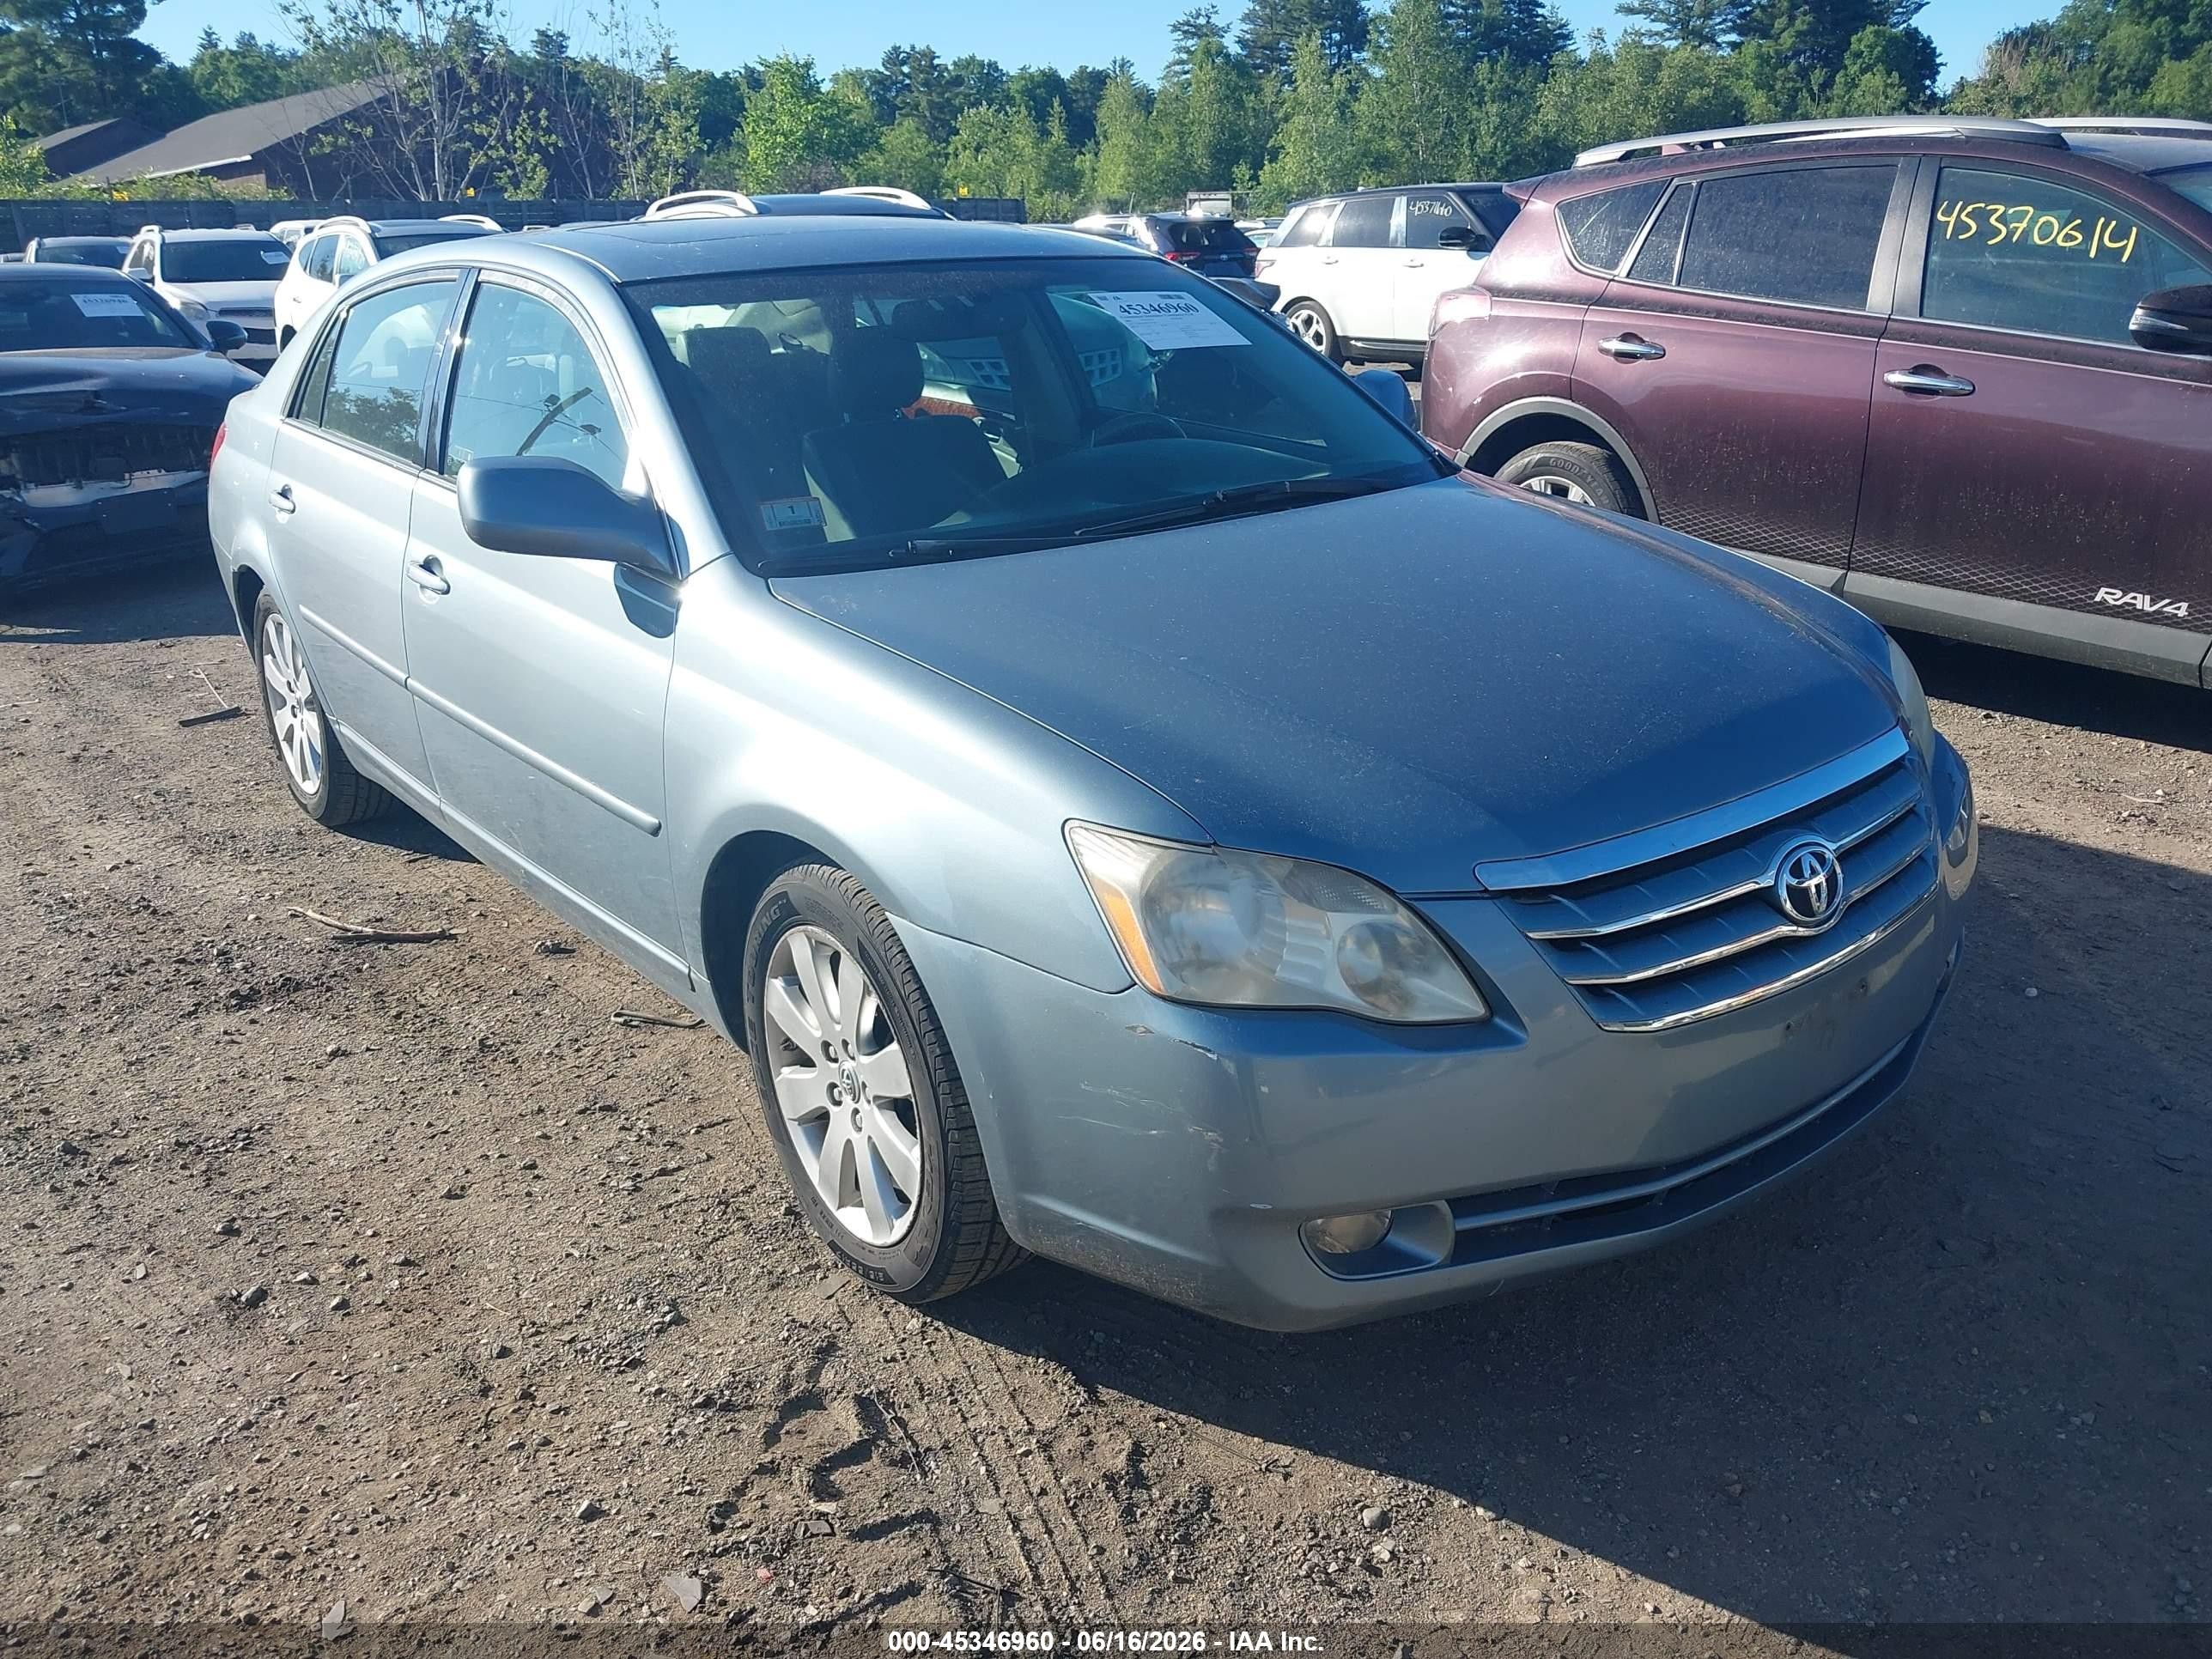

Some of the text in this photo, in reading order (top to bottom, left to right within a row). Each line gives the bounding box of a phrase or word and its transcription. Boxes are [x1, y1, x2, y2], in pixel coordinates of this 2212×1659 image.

[1936, 200, 2137, 263] 45370614
[1119, 302, 1200, 315] 45346960
[2094, 586, 2190, 617] RAV4
